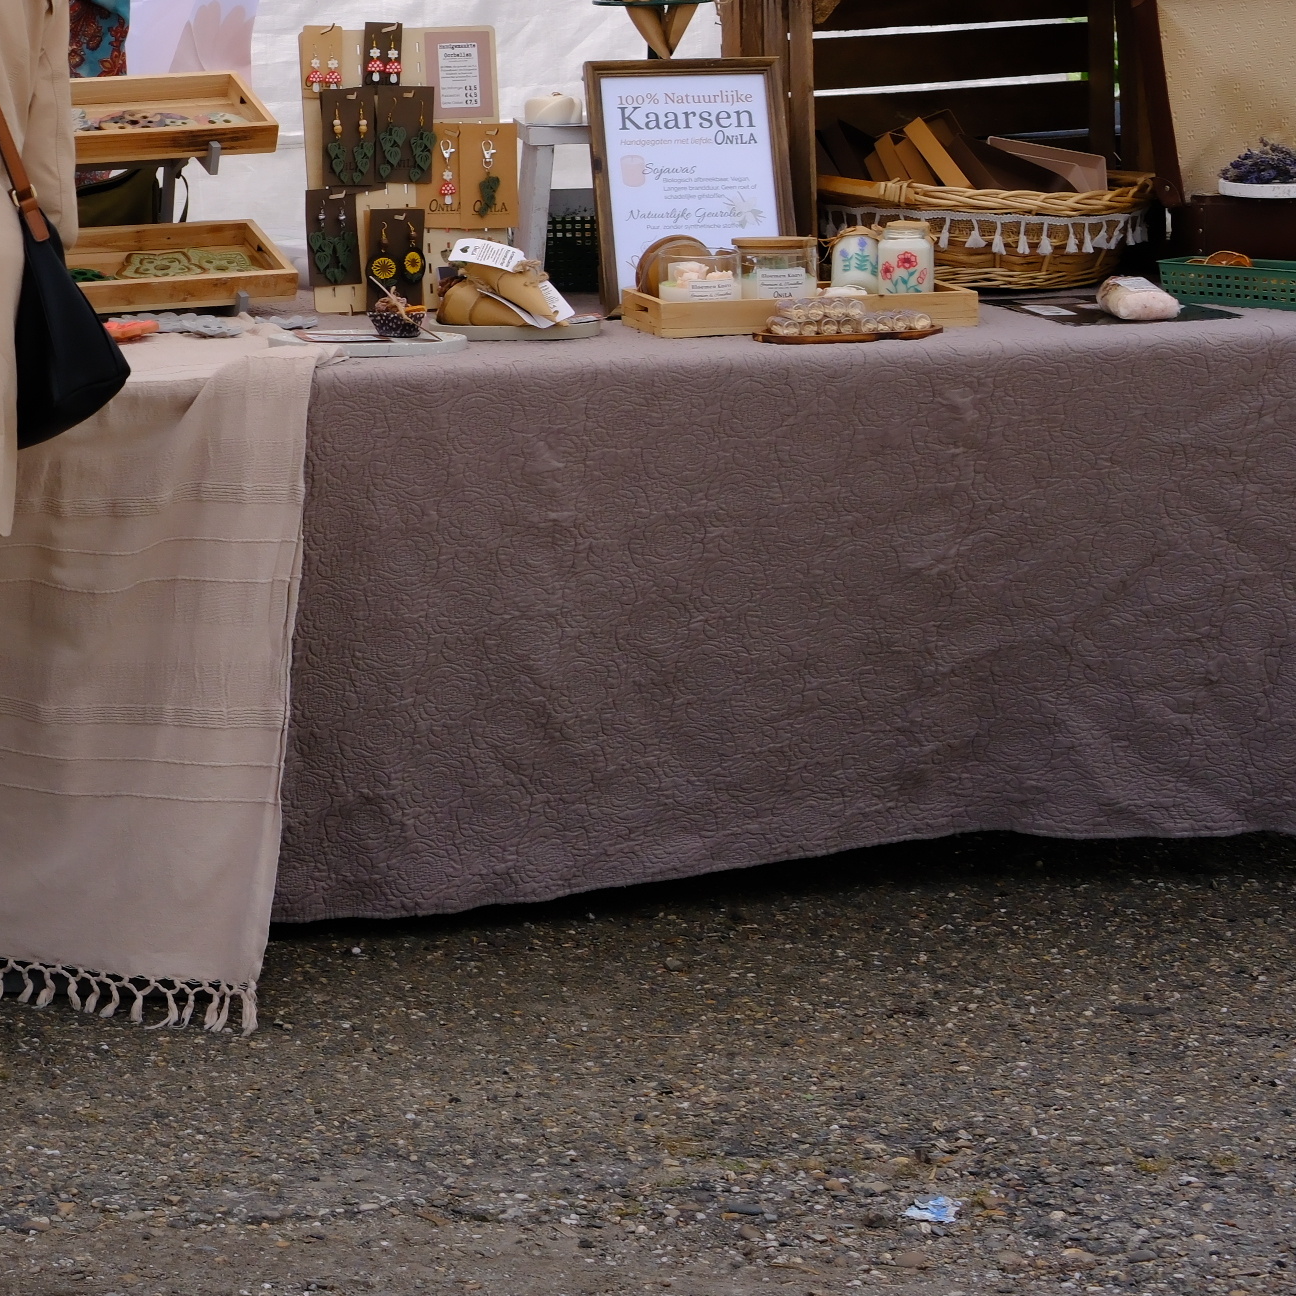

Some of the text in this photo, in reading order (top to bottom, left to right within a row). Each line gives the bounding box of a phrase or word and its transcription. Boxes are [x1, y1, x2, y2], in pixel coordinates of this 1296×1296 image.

[618, 90, 752, 105] 100% Natuurlijke
[618, 106, 754, 130] Kaarsen
[642, 162, 697, 180] Sojawas
[626, 208, 690, 223] Natuurlijke
